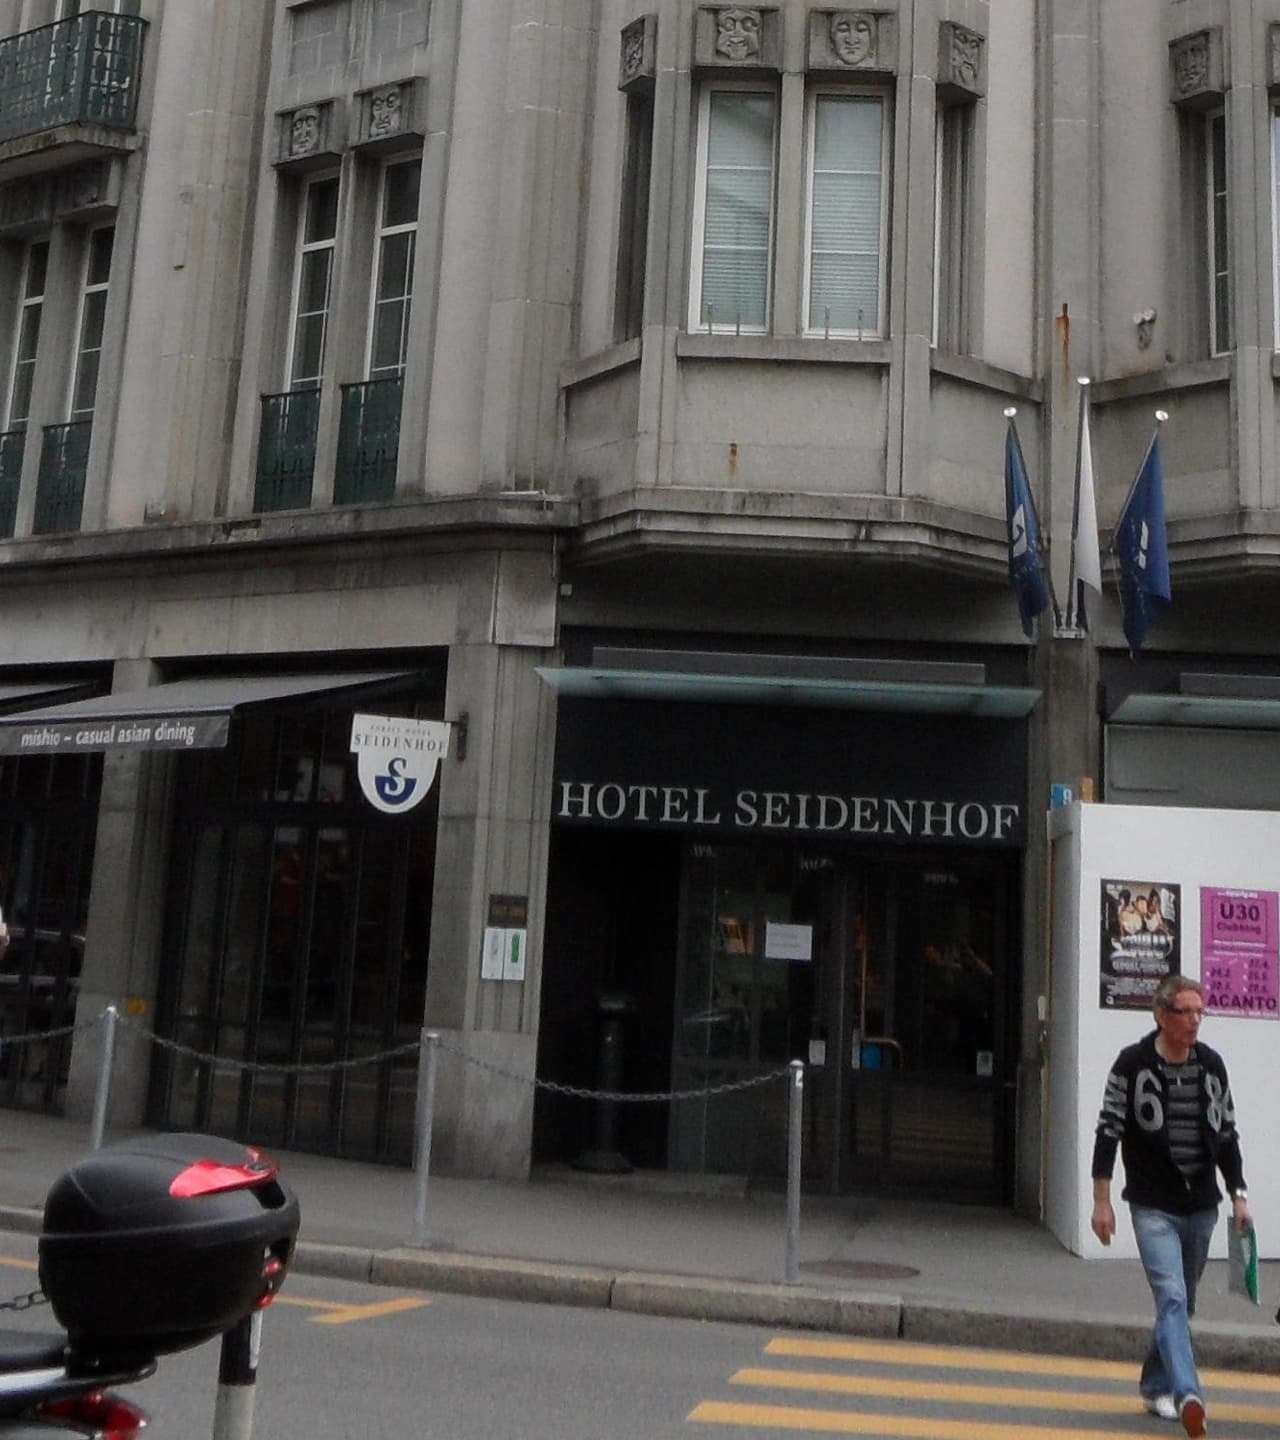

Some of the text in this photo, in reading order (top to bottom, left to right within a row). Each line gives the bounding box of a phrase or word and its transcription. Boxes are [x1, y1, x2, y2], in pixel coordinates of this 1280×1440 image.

[21, 727, 60, 747] mishio
[75, 725, 115, 745] casual
[117, 724, 151, 744] asian
[154, 721, 196, 746] dining
[353, 733, 446, 753] SEIDENHOF
[557, 781, 1021, 840] HOTEL SEIDENHOF
[1207, 993, 1277, 1011] ACANTO
